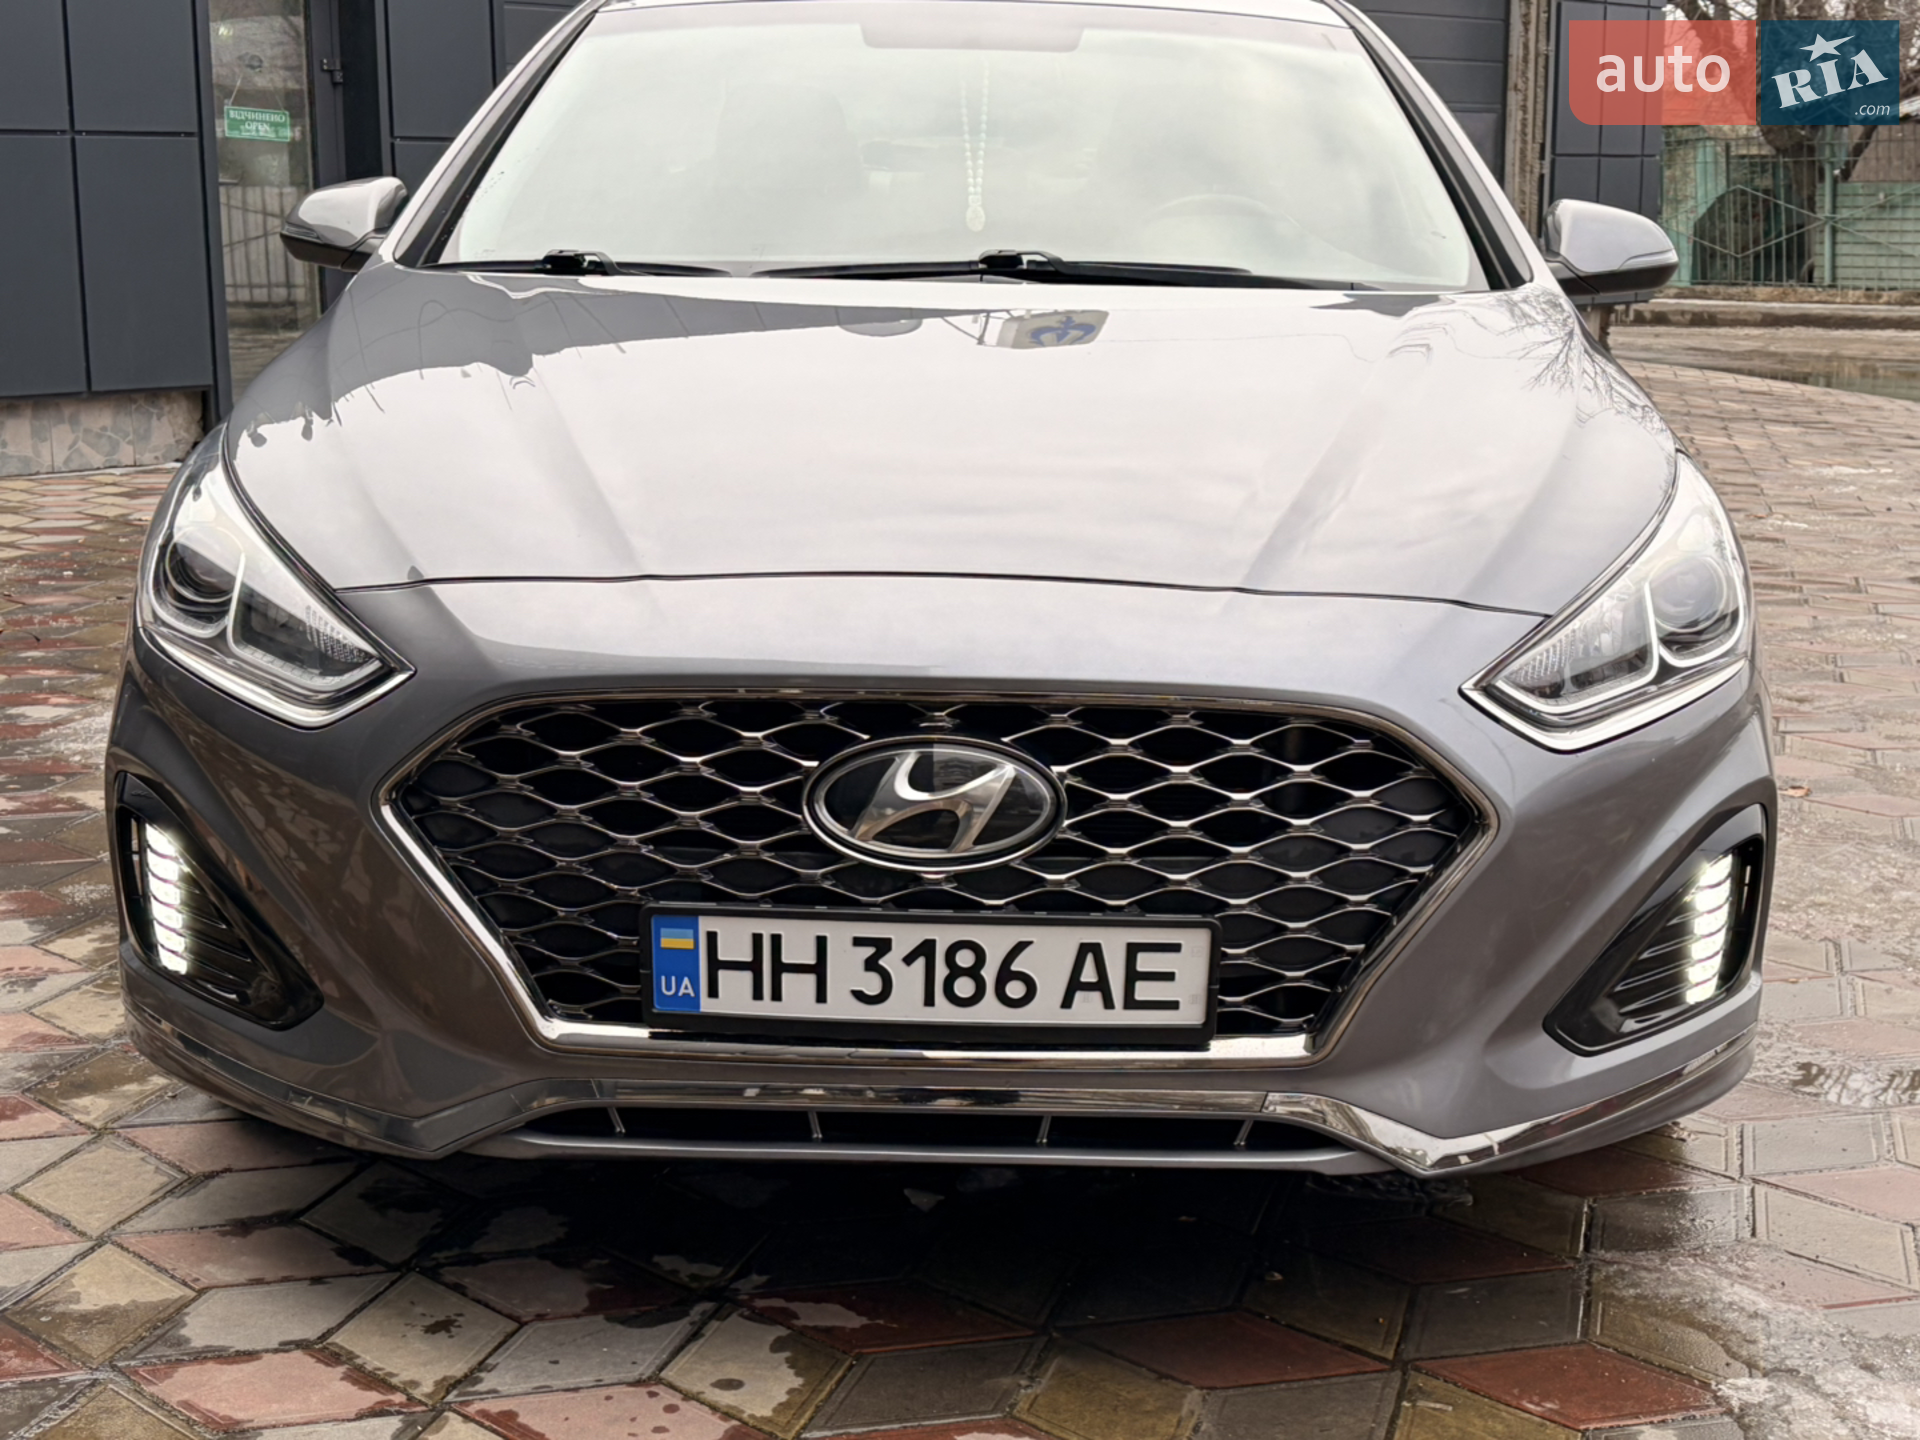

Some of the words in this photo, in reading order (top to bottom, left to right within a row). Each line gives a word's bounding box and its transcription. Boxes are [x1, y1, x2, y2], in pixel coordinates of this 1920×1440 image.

[228, 109, 285, 123] ВІДЧИНЕНО
[244, 120, 270, 131] OPEN
[705, 930, 828, 1004] HH
[849, 936, 1038, 1009] 3186
[1059, 941, 1183, 1010] AE
[660, 975, 695, 998] UA
